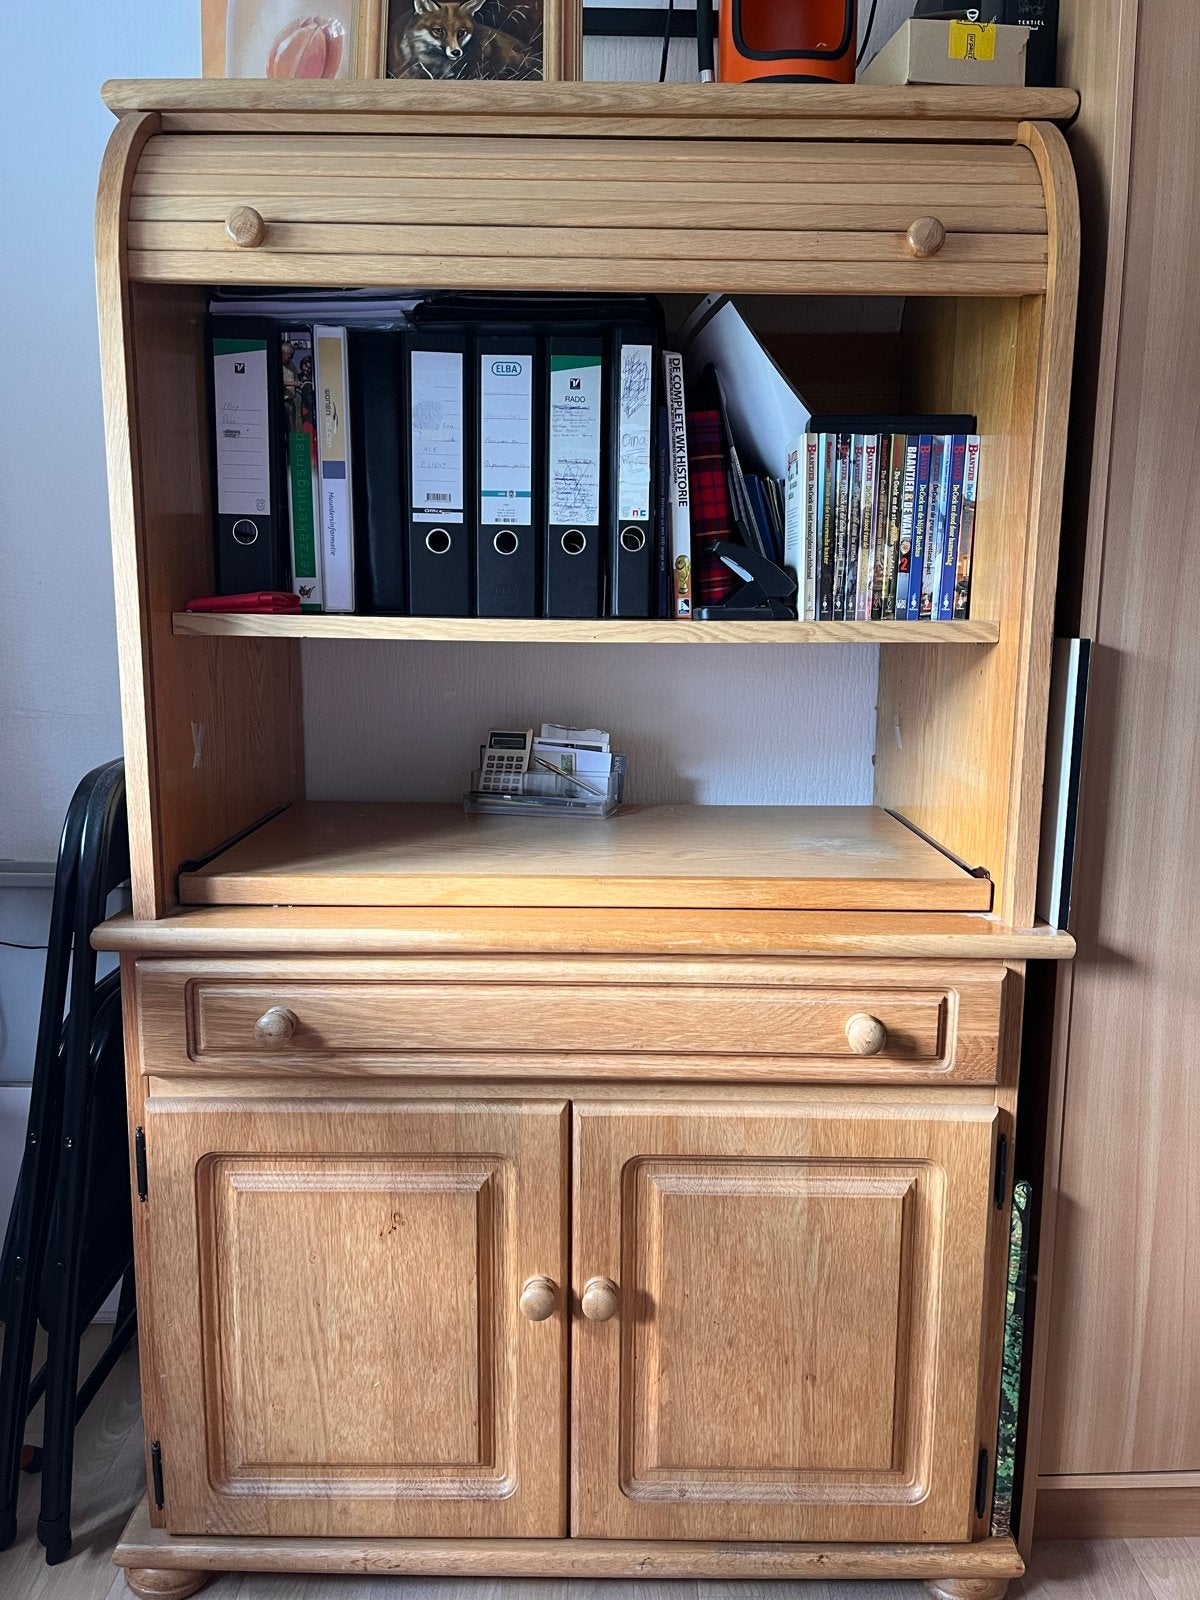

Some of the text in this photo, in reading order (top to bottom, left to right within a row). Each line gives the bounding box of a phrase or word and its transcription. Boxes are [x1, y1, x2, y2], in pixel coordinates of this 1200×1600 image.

[496, 365, 518, 373] ELBA
[672, 358, 688, 507] DE COMPLETE WK HISTORIE
[807, 444, 817, 482] BAANTJER
[826, 472, 832, 480] De
[840, 444, 849, 481] BAANTJER
[855, 446, 863, 484] BAANTJER
[866, 446, 875, 482] BAANTJER
[880, 470, 887, 478] De
[894, 471, 901, 480] De
[920, 445, 930, 481] BAANTJER
[934, 444, 943, 482] BAANTJER
[954, 445, 965, 481] BAANTJER
[968, 444, 979, 481] BAANTJER
[296, 433, 310, 577] Verzekeringsmap
[933, 484, 939, 492] De
[953, 484, 960, 492] De
[327, 492, 337, 556] Huurdersinformatie
[892, 505, 898, 513] de
[900, 446, 917, 571] BAANTJER & DE WAAL 2
[916, 520, 925, 535] blijde
[945, 538, 955, 566] hamerslag
